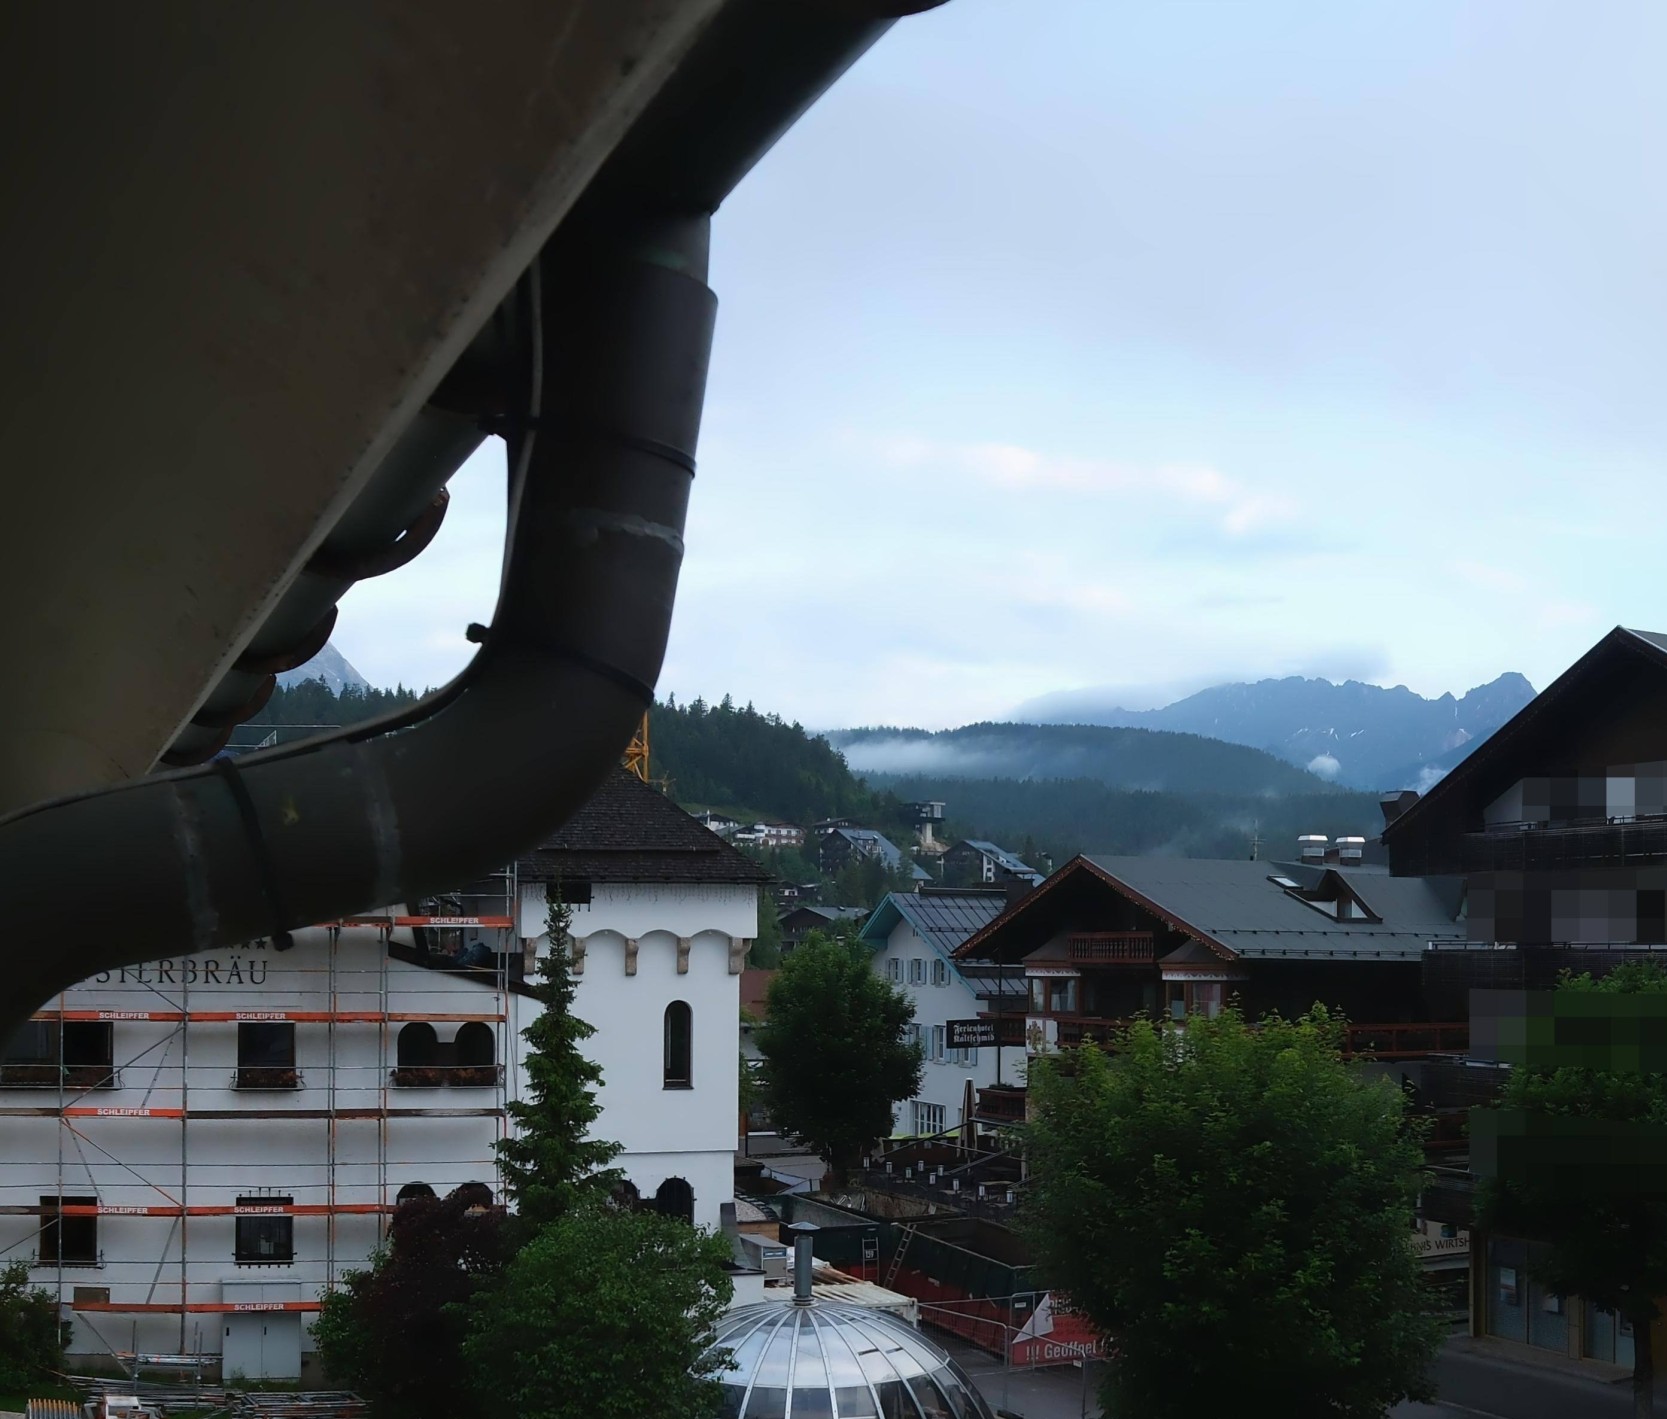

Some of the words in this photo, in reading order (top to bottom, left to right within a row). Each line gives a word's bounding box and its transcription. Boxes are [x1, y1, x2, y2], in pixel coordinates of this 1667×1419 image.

[430, 916, 479, 924] SCHLEIPFER
[99, 1011, 150, 1020] SCHLEIPFER
[235, 1011, 286, 1020] SCHLEIPFER
[97, 1107, 148, 1117] SCHLEIPFER
[97, 1206, 148, 1214] SCHLEIPFER
[234, 1303, 284, 1311] SCHLEIPFER
[1044, 1339, 1097, 1359] Geöffnet
